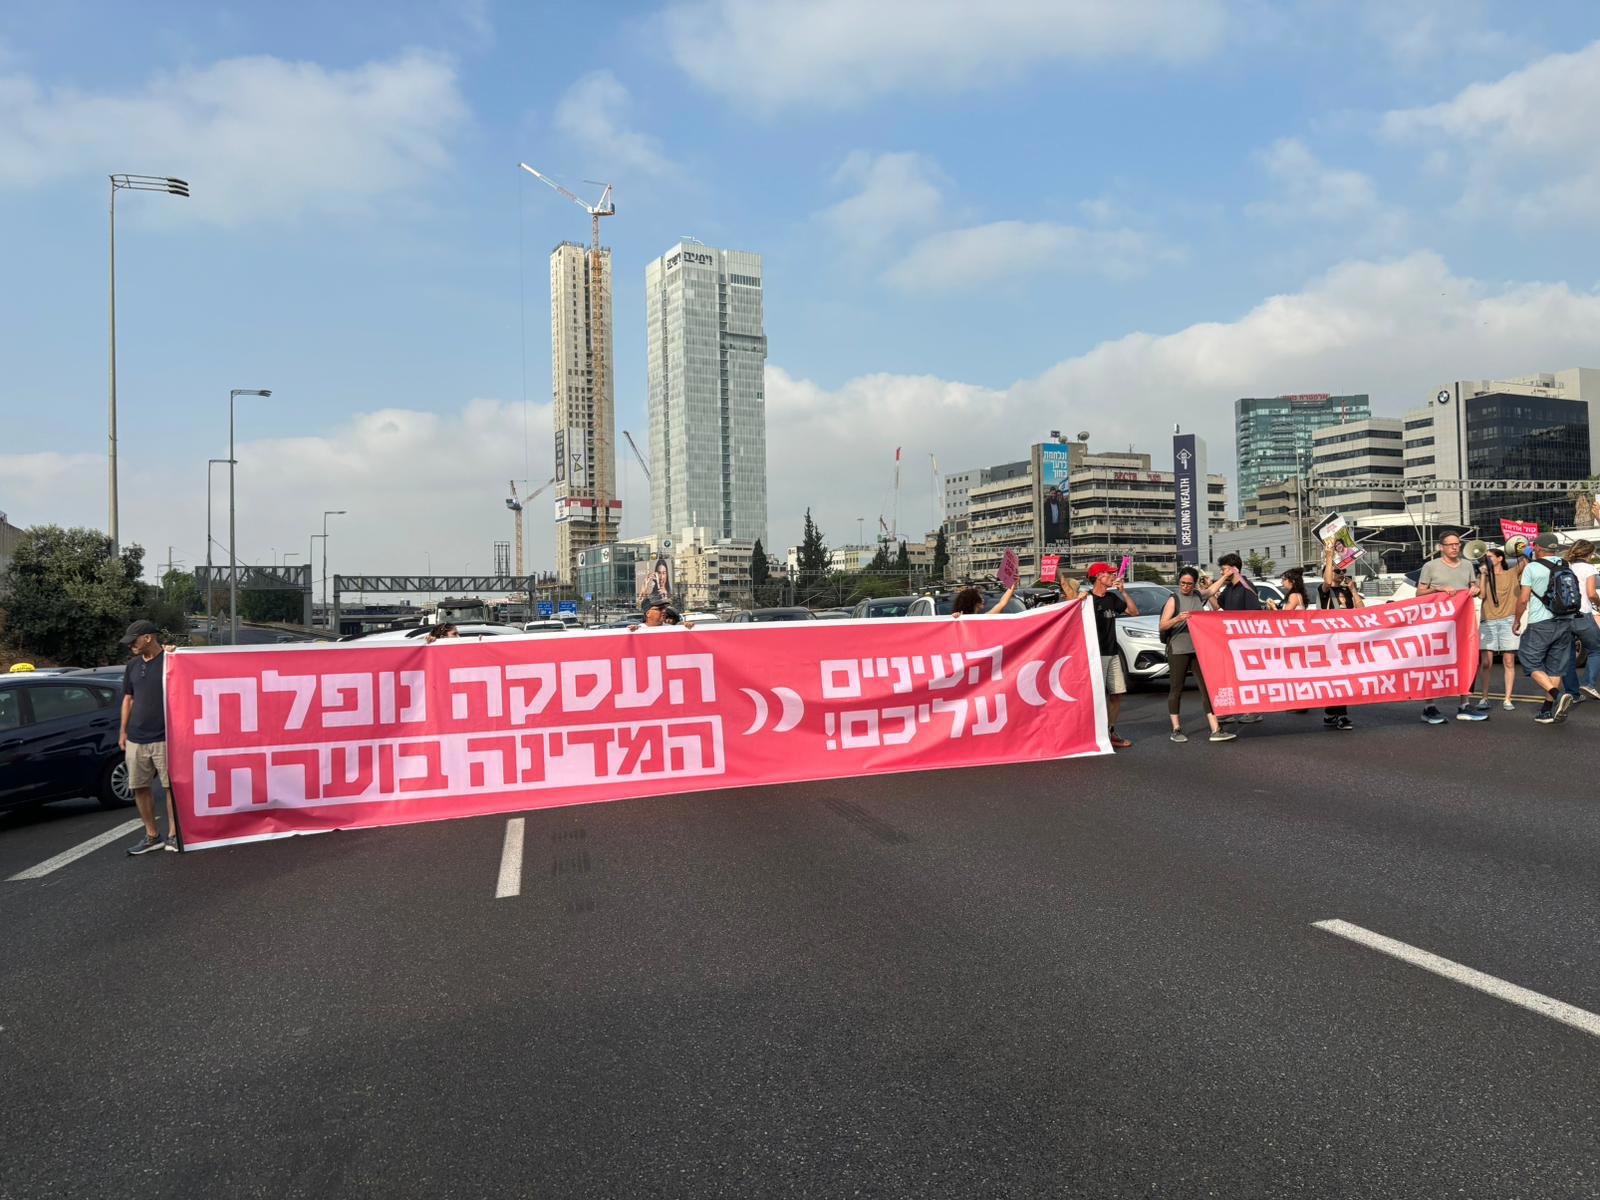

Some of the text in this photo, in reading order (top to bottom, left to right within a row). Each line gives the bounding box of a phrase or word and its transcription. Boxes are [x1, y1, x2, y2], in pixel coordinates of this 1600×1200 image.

[1180, 477, 1190, 509] WEALTH
[1182, 509, 1192, 546] CREATING
[1222, 600, 1455, 636] עסקה או גזר דין מוות
[1239, 632, 1450, 671] בוחרות בחיים
[820, 645, 1003, 699] העיניים
[1359, 674, 1396, 696] את
[1403, 668, 1459, 692] הצילו
[194, 653, 716, 735] העסקה נופלת
[1239, 678, 1354, 705] החטופים
[825, 693, 1008, 750] עליכם!
[207, 722, 715, 808] המדינה בוערת
